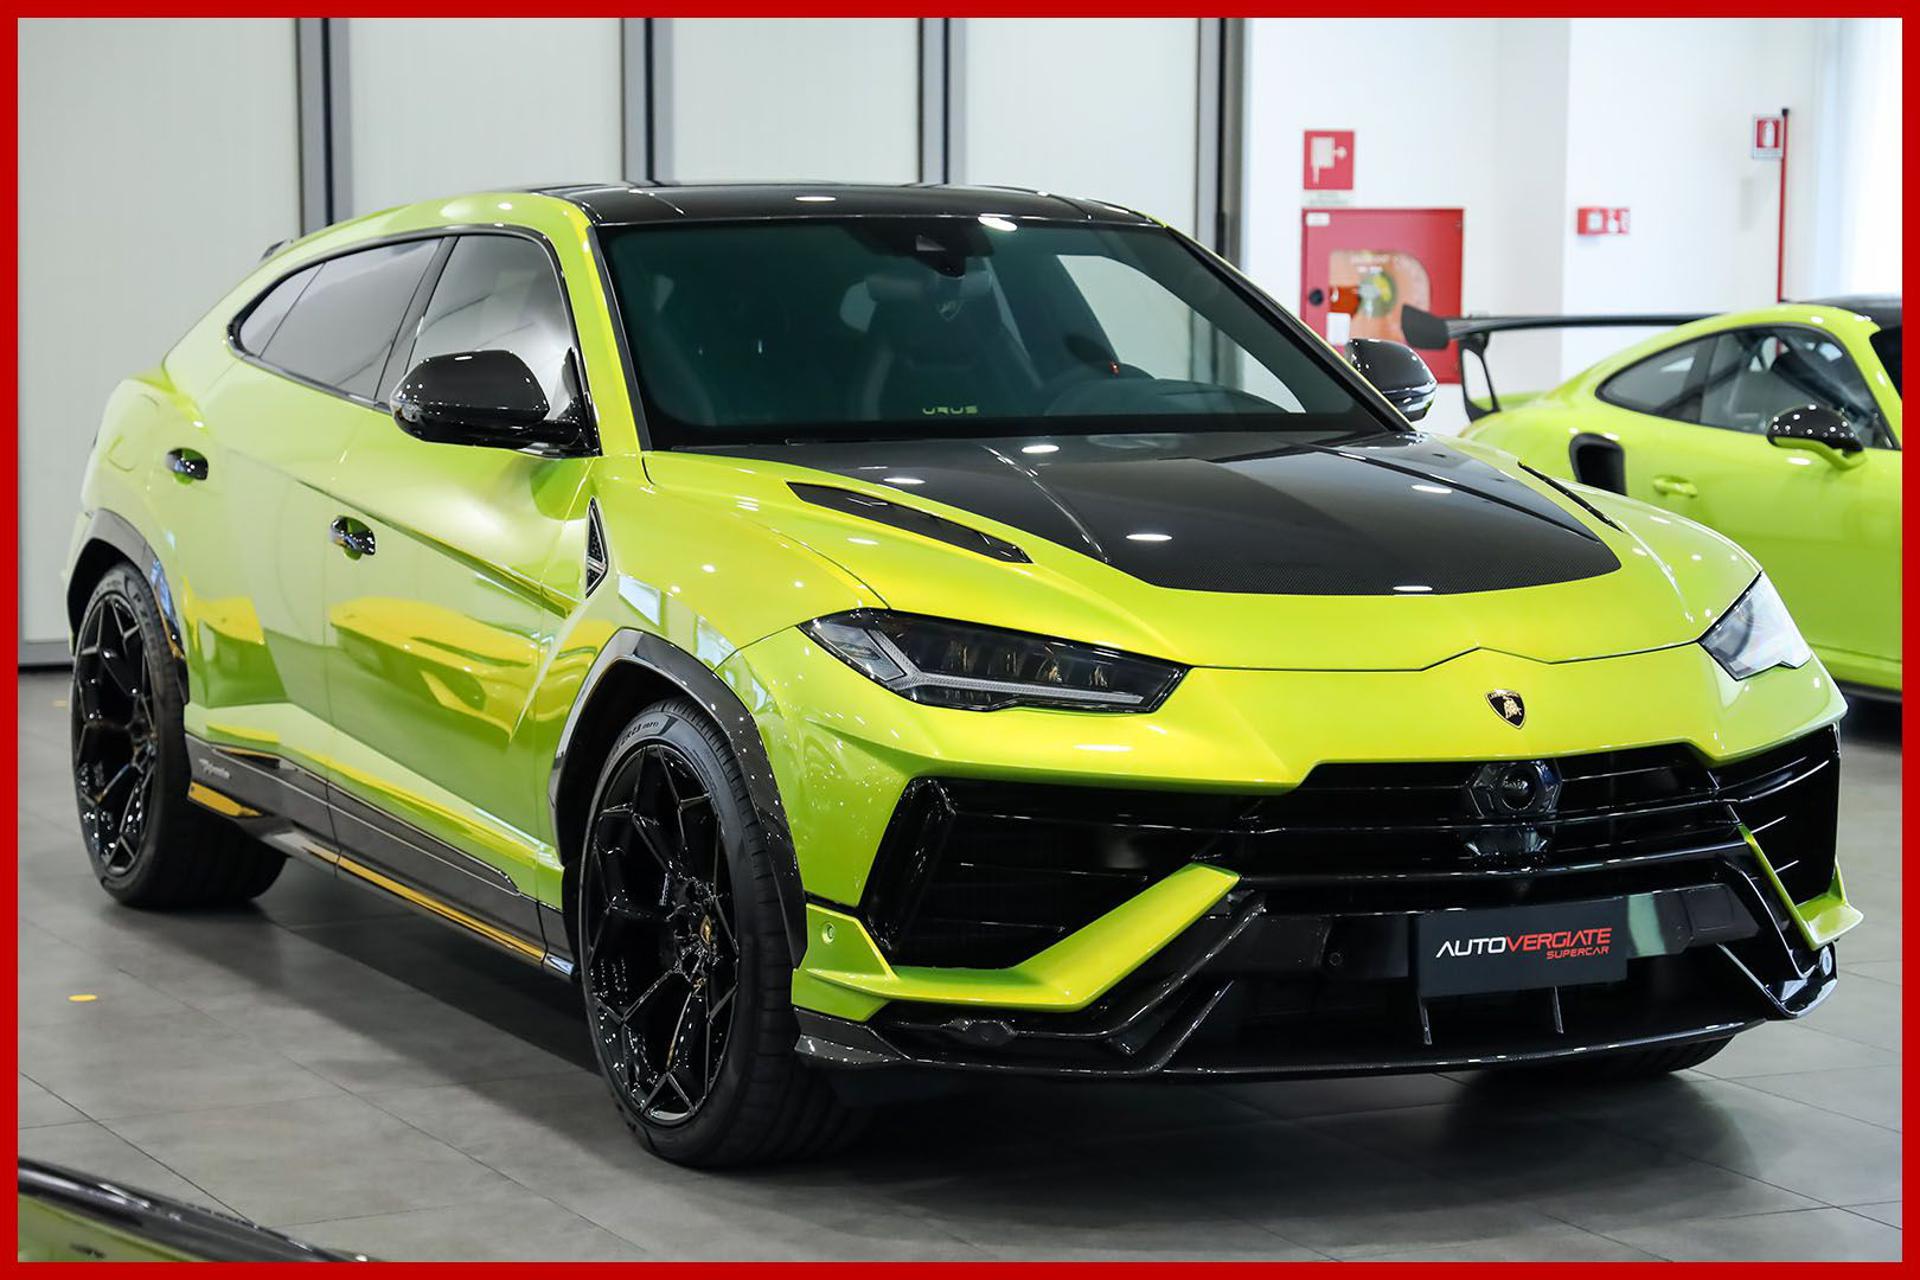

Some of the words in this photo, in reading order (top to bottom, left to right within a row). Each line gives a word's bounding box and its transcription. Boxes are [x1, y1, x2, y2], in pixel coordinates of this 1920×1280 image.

[922, 405, 978, 415] URUS
[1436, 928, 1612, 958] AUTOVERGIATE
[1546, 946, 1609, 960] SUPERCAR
